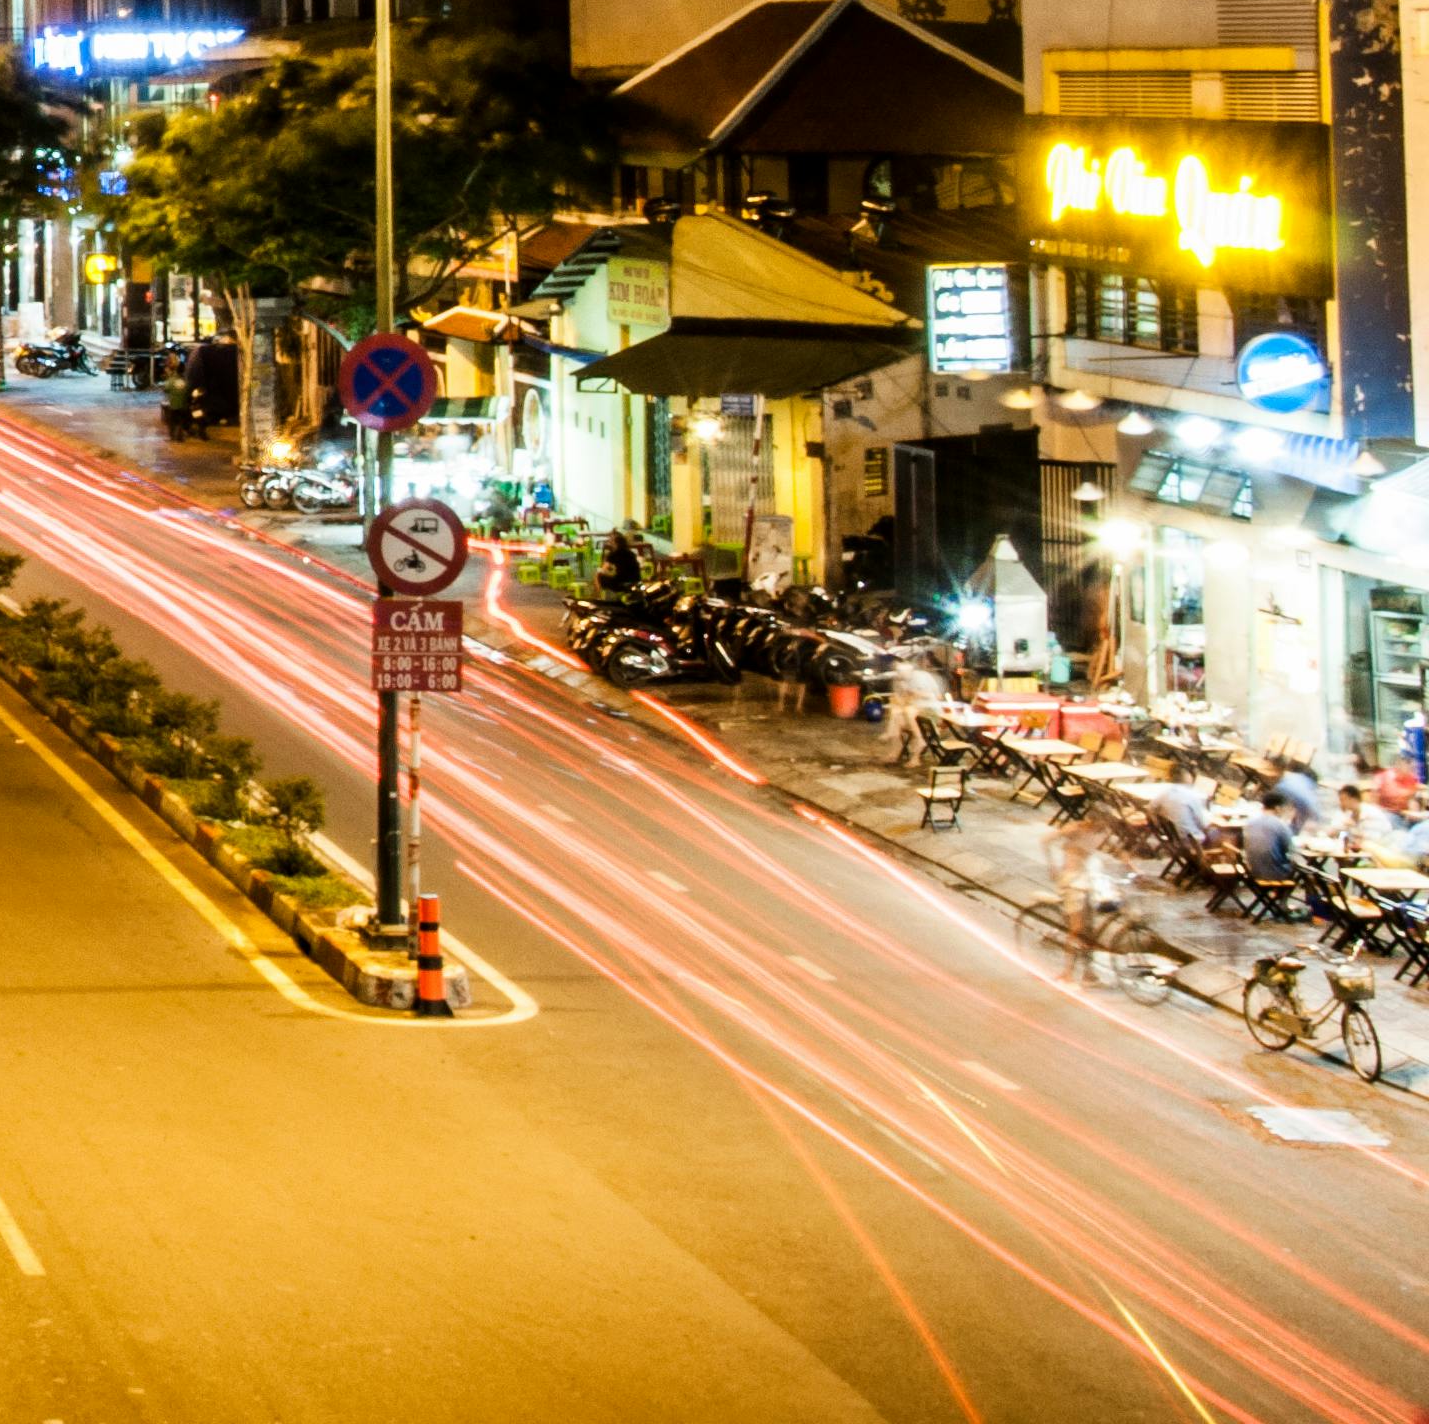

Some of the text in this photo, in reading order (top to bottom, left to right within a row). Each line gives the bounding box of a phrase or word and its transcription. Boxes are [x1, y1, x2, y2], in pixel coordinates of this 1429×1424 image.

[609, 282, 630, 303] KIM
[390, 602, 445, 632] CẤM
[378, 636, 390, 651] XE
[394, 637, 401, 651] 2
[404, 633, 416, 652] VÀ
[420, 637, 427, 652] 3
[427, 674, 457, 689] 6:00
